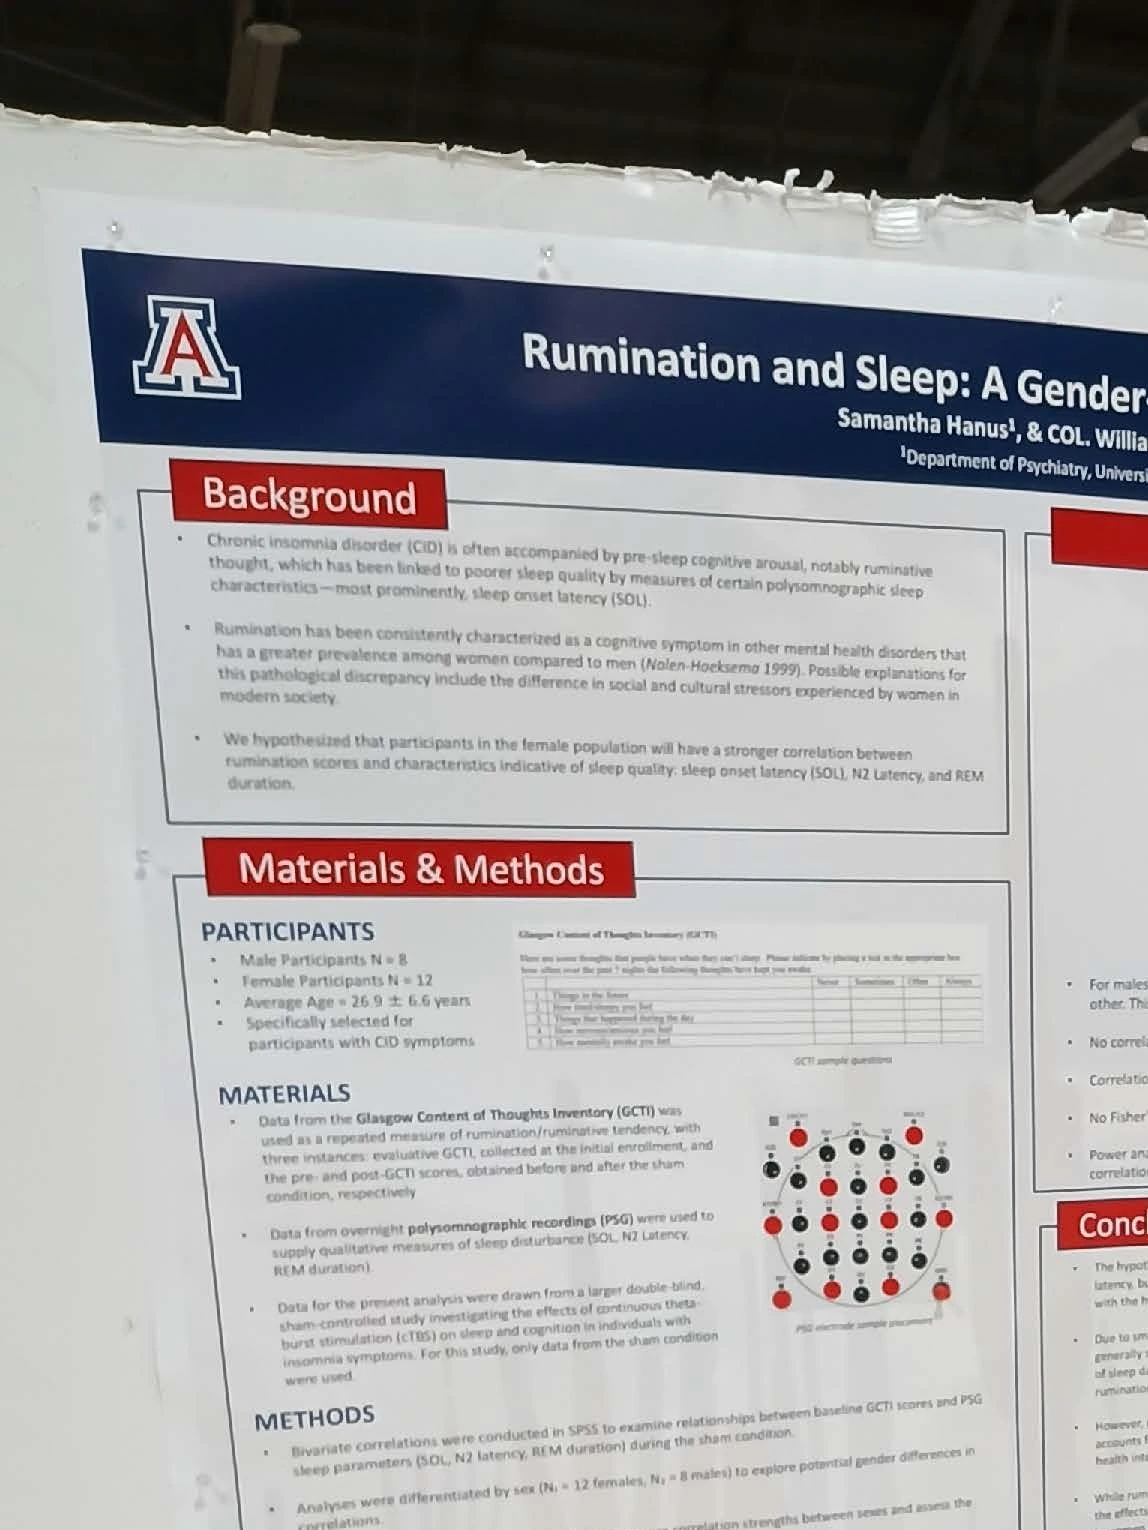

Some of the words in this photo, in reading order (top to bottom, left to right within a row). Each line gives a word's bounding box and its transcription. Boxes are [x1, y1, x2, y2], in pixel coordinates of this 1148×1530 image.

[132, 294, 242, 400] A
[524, 333, 760, 382] Rumination
[773, 352, 844, 388] and
[856, 355, 969, 404] Sleep:
[982, 366, 1008, 400] A
[838, 407, 940, 433] Samantha
[1027, 422, 1042, 442] &
[1048, 424, 1090, 446] COL.
[1000, 455, 1015, 471] of
[1018, 457, 1091, 480] Psychiatry,
[205, 477, 416, 518] Background
[240, 852, 405, 883] Materials
[417, 853, 444, 883] &
[455, 853, 604, 885] Methods
[202, 922, 374, 941] PARTICIPANTS
[240, 952, 277, 966] Male
[281, 951, 367, 970] Participants
[371, 951, 382, 965] N
[399, 951, 407, 965] 8
[242, 973, 295, 987] Female
[299, 972, 384, 991] Participants
[388, 972, 399, 986] N
[417, 972, 432, 986] 12
[219, 1084, 350, 1104] MATERIALS
[255, 1405, 374, 1431] METHODS
